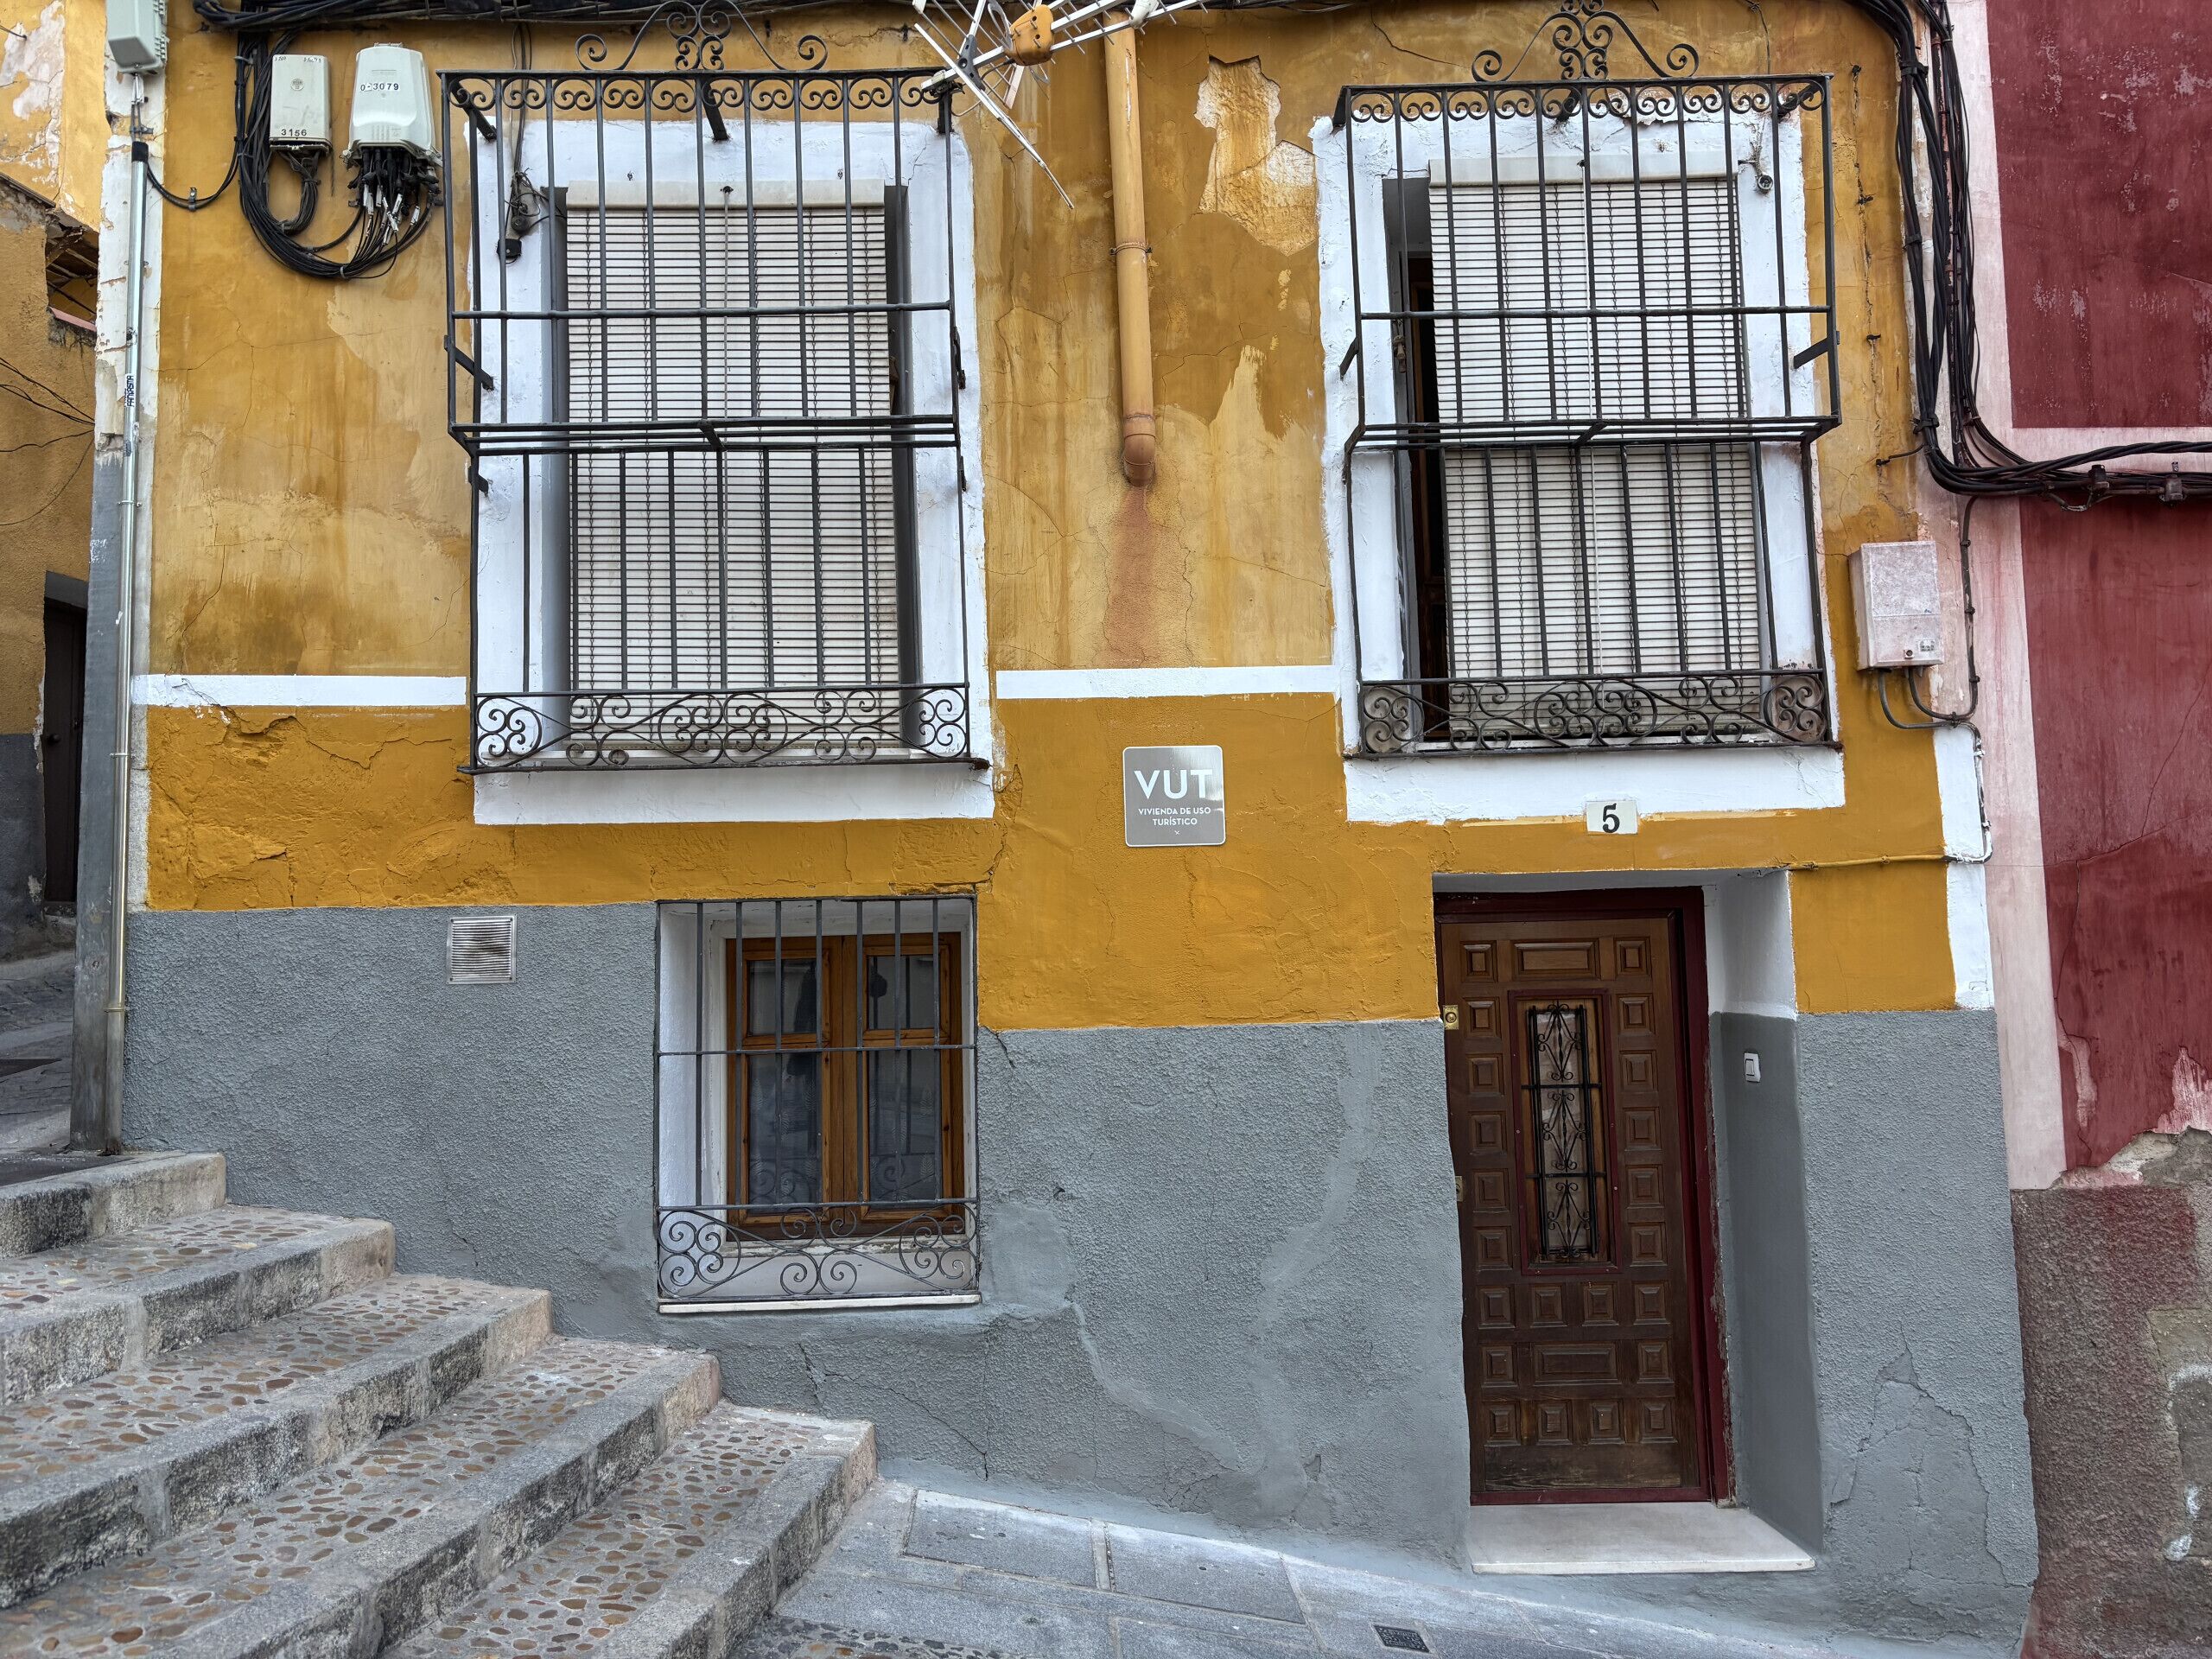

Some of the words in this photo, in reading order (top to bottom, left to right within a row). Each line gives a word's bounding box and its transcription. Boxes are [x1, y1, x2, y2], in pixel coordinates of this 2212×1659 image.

[281, 128, 308, 137] 3156
[1134, 769, 1213, 800] VUT
[1138, 807, 1179, 816] VIVIENDA
[1152, 817, 1198, 826] TURÍSTICO
[1602, 803, 1620, 834] 5
